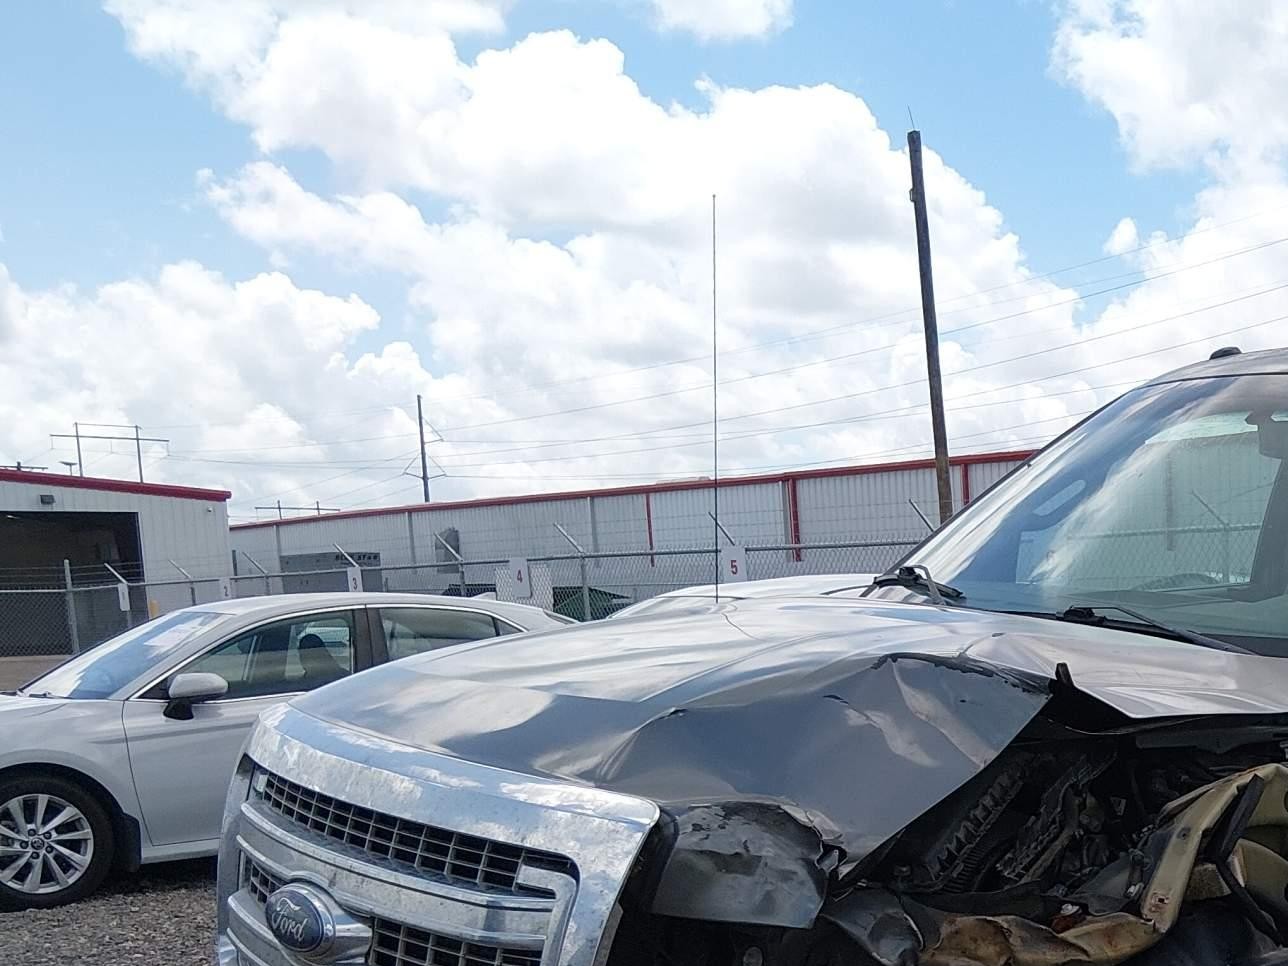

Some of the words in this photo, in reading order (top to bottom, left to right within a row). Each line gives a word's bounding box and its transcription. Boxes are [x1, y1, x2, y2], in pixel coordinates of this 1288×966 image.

[730, 559, 738, 575] 5
[352, 577, 358, 590] 3
[516, 569, 523, 583] 4
[271, 897, 308, 941] Ford
